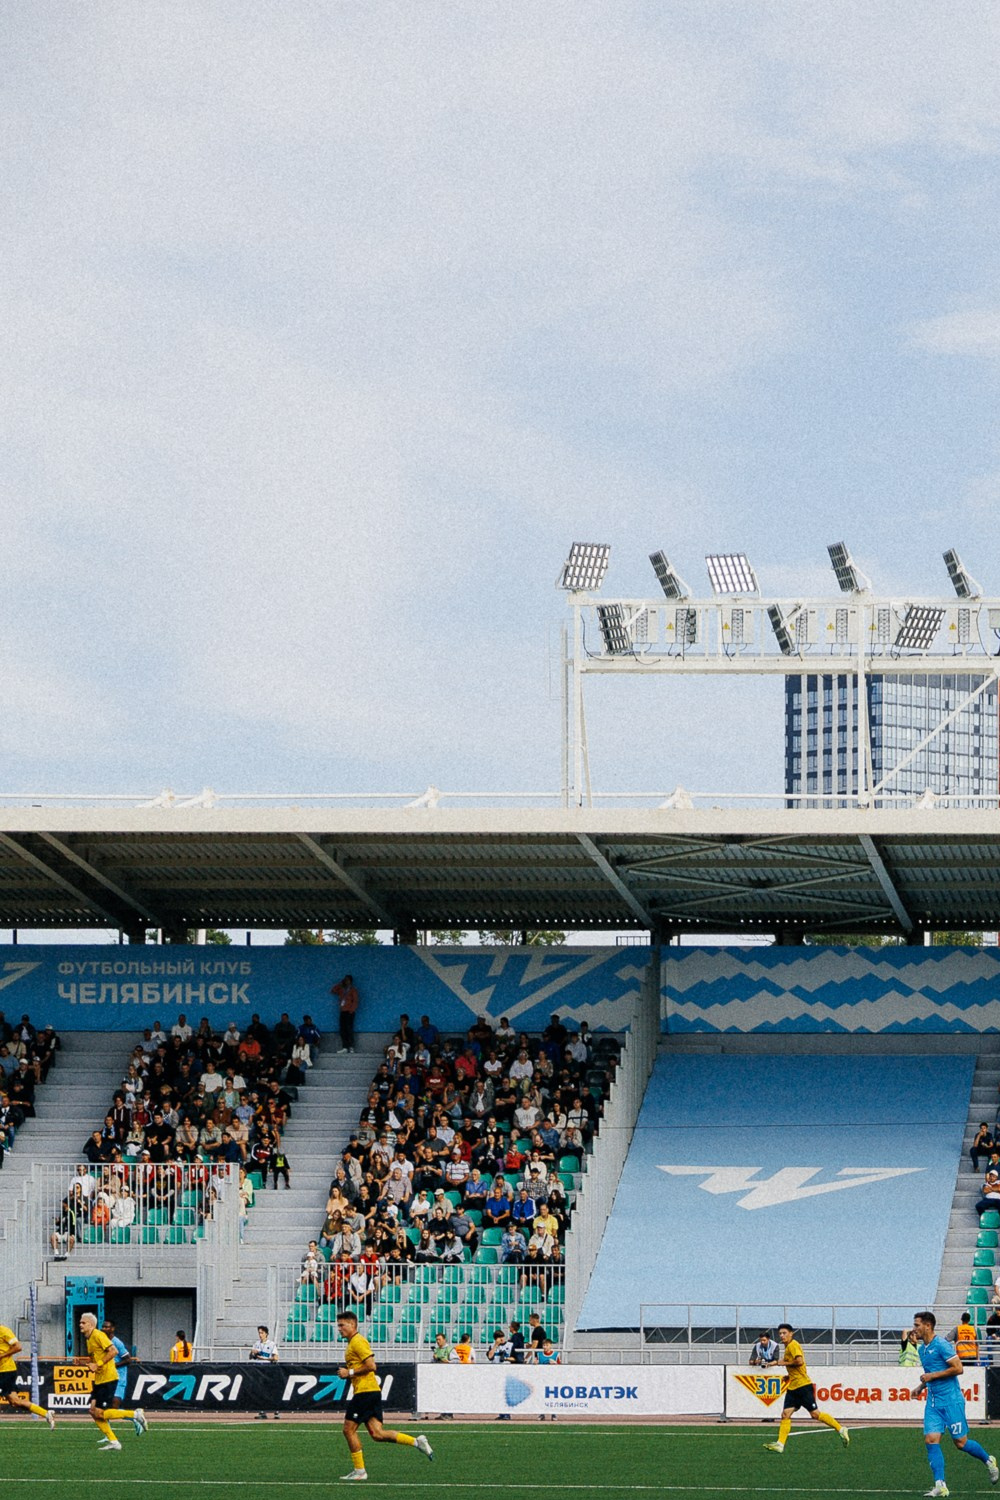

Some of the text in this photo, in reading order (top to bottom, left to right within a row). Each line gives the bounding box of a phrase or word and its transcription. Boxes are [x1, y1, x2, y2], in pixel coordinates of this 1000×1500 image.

[58, 959, 251, 975] ФУТБОЛЬНЫЙ КЛУБ
[57, 983, 251, 1004] ЧЕЛЯБИНСК
[58, 1369, 91, 1378] FOOT
[58, 1382, 89, 1392] BALL
[131, 1374, 243, 1401] PARI
[281, 1374, 394, 1401] PAI
[544, 1386, 639, 1399] НОВАТЭК
[888, 1388, 910, 1401] за
[950, 1422, 962, 1435] 27
